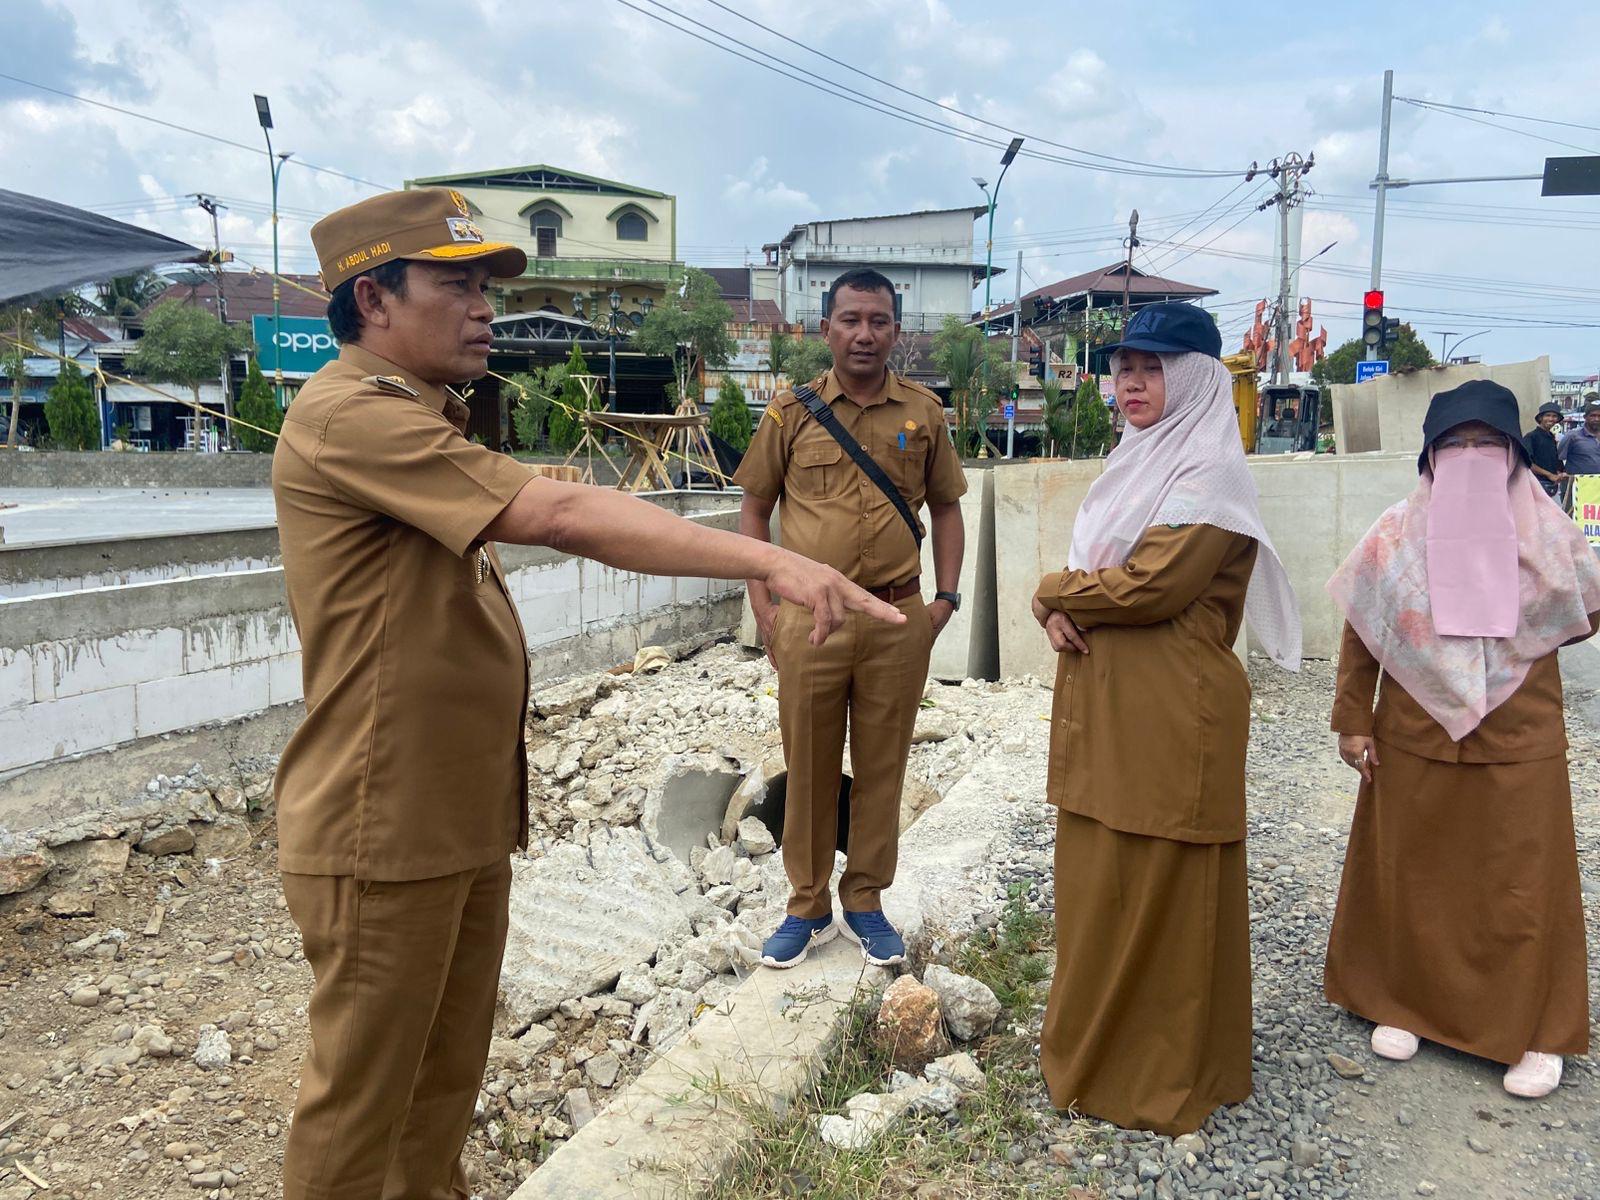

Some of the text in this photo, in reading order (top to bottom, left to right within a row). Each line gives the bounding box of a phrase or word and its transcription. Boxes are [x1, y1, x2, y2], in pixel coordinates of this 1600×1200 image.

[345, 251, 370, 268] ABDUL
[370, 242, 392, 257] HADI
[1057, 370, 1073, 379] R2
